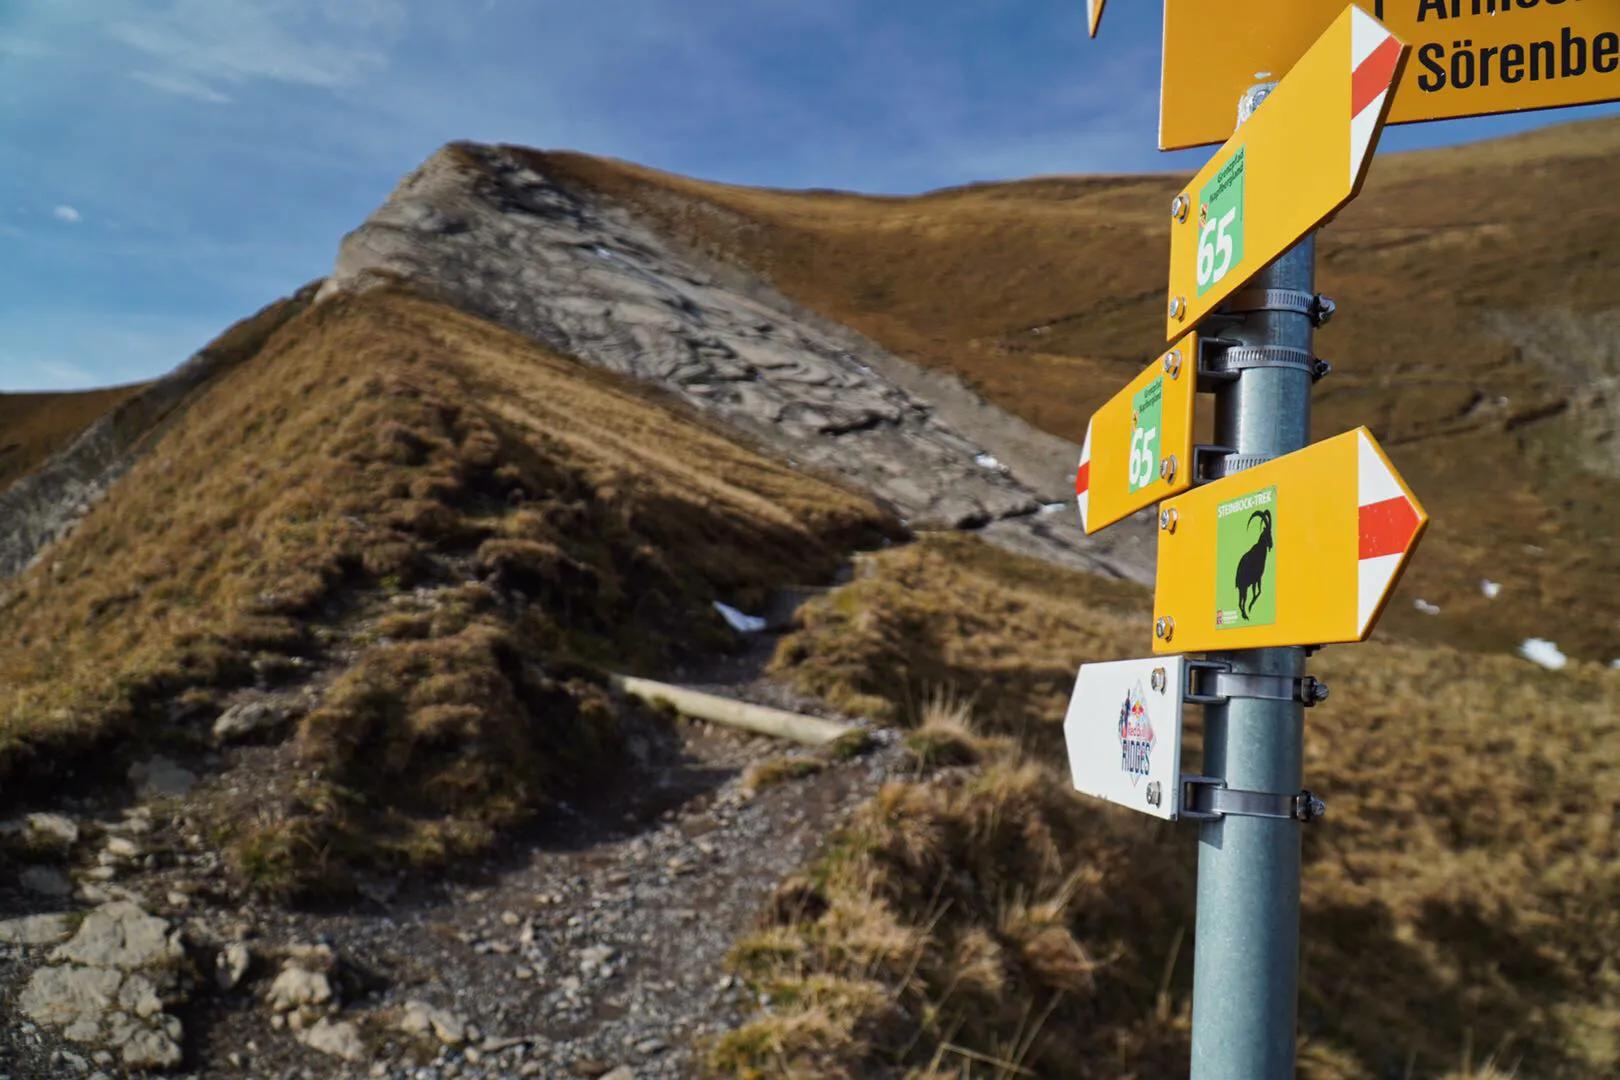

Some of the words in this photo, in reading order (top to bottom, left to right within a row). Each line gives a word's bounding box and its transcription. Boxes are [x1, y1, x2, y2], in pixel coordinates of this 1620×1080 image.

[1197, 207, 1235, 286] 65
[1129, 427, 1155, 488] 65
[1121, 739, 1150, 775] RIDGES
